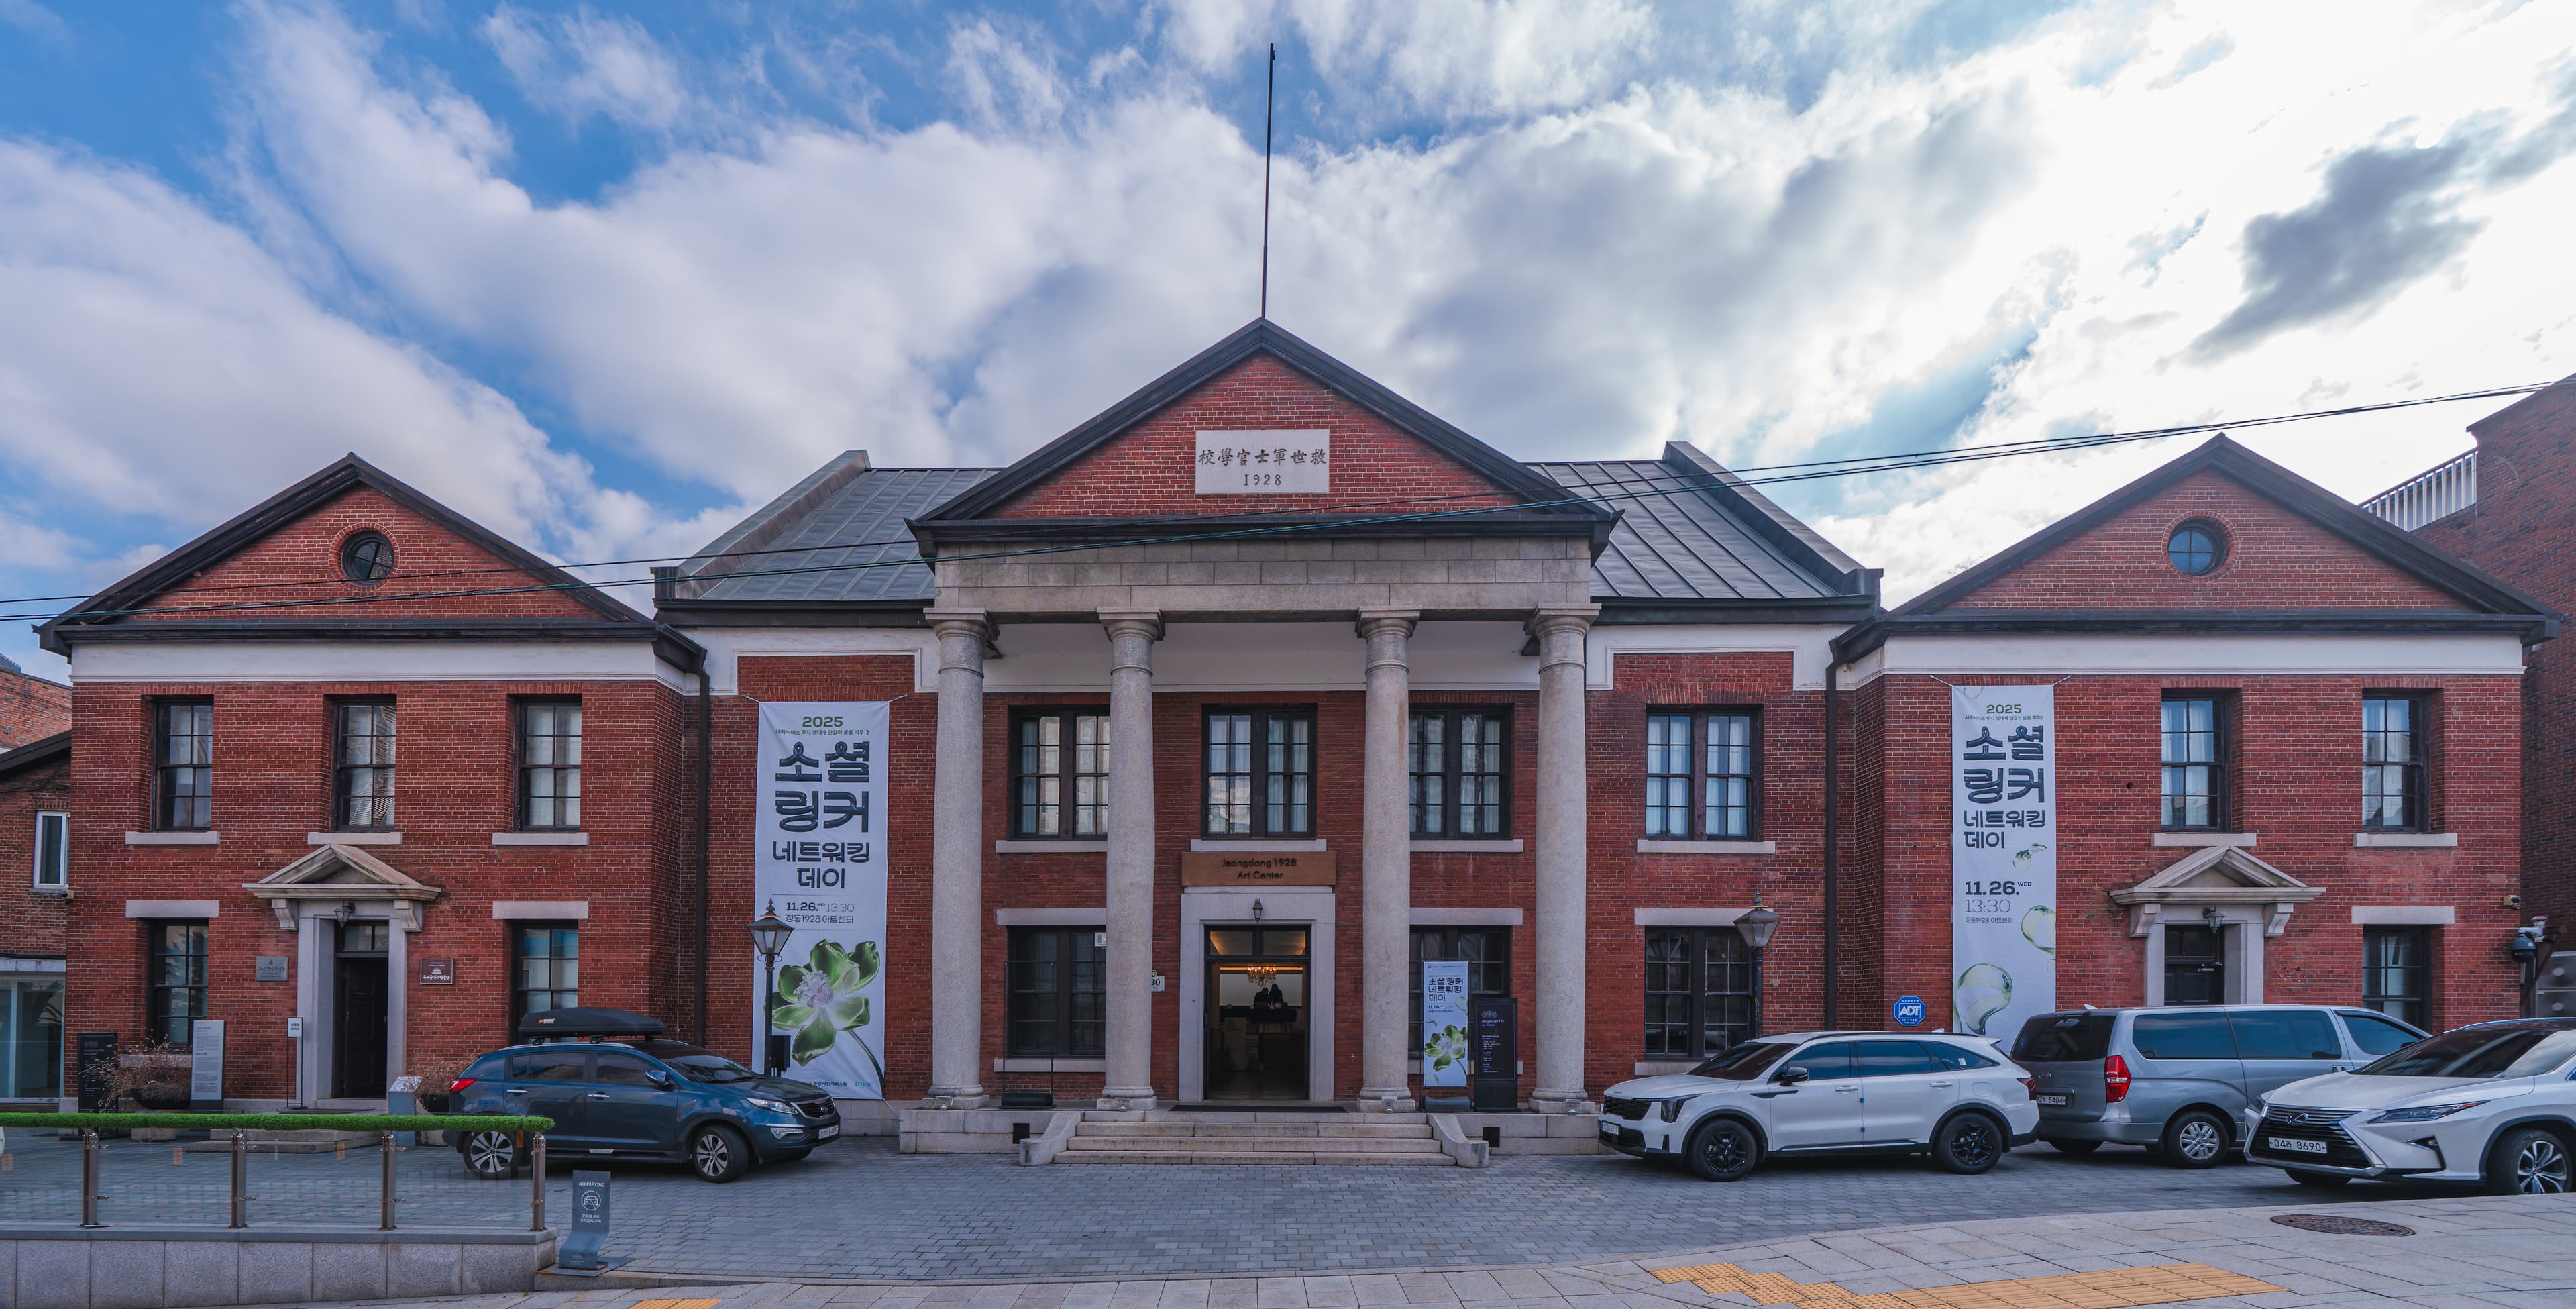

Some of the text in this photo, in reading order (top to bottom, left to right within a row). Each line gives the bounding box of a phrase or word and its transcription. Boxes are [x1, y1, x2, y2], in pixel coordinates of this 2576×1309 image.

[1243, 474, 1282, 486] 1928
[1986, 704, 2022, 714] 2025
[802, 716, 843, 727] 2025
[1963, 725, 2044, 761] 소셜
[775, 741, 870, 782] 소셜
[1964, 768, 2045, 804] 링커
[775, 790, 869, 832] 링커
[1964, 810, 2045, 828] 네트워킹
[1964, 831, 2004, 849] 데이
[773, 841, 870, 863] 네트워킹
[1222, 858, 1297, 868] Jeongdong 1928
[797, 868, 845, 889] 데이
[1236, 871, 1283, 880] Art Center
[1965, 881, 2020, 896] 11.26.
[786, 902, 818, 911] 11.26.
[826, 903, 855, 912] 13:30
[1966, 899, 2011, 913] 13:30
[786, 914, 854, 923] 정동1928 아트센터
[1900, 1006, 1921, 1016] ADT
[2296, 1141, 2321, 1151] 8690
